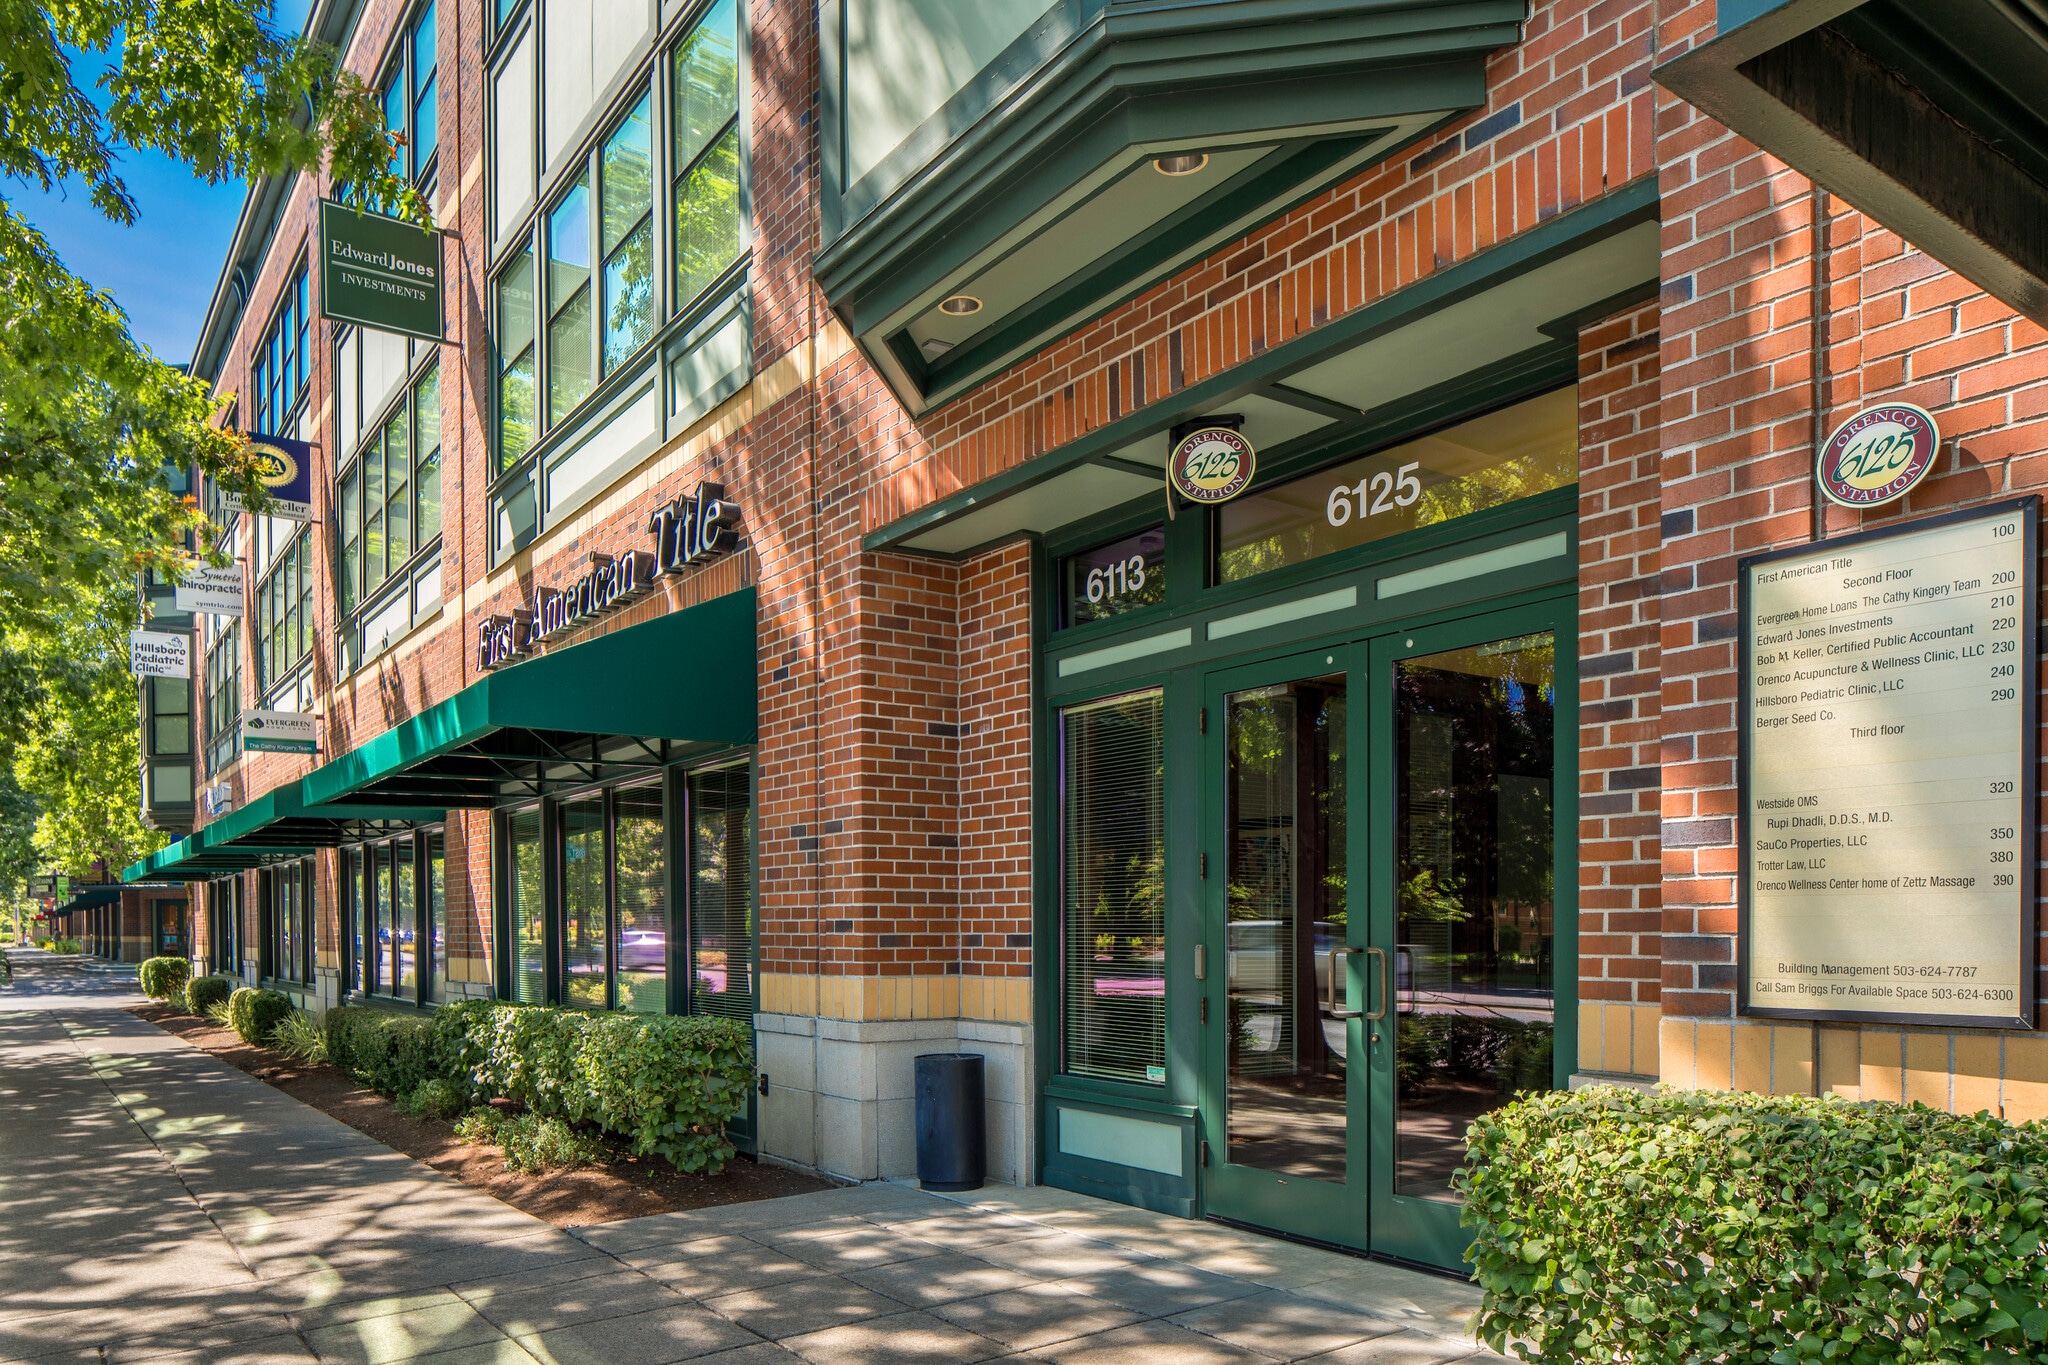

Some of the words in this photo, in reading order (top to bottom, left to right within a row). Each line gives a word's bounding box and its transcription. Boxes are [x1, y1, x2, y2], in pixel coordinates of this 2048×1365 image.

[342, 272, 426, 301] INVESTMENTS
[1835, 410, 1918, 449] ORENCO
[1184, 432, 1242, 454] ORENCO
[1832, 425, 1923, 482] 6125
[1181, 450, 1245, 480] 6125
[1184, 474, 1244, 498] STATION
[1838, 460, 1921, 501] STATION
[1326, 461, 1422, 527] 6125
[1757, 570, 1778, 584] First
[1780, 562, 1828, 580] American
[1830, 558, 1852, 570] Title
[1992, 523, 2016, 538] 100
[180, 580, 242, 594] hiropractic
[195, 567, 241, 583] Symtrio
[476, 607, 525, 672] First
[526, 549, 645, 646] American
[649, 480, 733, 579] Title
[1086, 554, 1146, 603] 6113
[1843, 572, 1882, 589] Second
[1886, 568, 1914, 582] Floor
[196, 601, 242, 610] symtrio.com
[1757, 610, 1799, 626] Evergreen
[1802, 604, 1828, 618] Home
[1830, 600, 1858, 613] Loans
[1862, 596, 1880, 608] The
[1882, 590, 1910, 604] Cathy
[1912, 584, 1950, 598] Kingery
[1953, 578, 1981, 592] Team
[1992, 570, 2016, 585] 200
[1757, 630, 1793, 646] Edward
[1796, 627, 1826, 640] Jones
[1829, 616, 1893, 635] Investments
[1990, 594, 2015, 609] 210
[134, 642, 186, 656] Hillsboro
[1757, 654, 1776, 666] Bob
[1793, 648, 1824, 660] Keller,
[1826, 638, 1870, 655] Certified
[1874, 634, 1906, 648] Public
[1909, 624, 1974, 644] Accountant
[1992, 617, 2016, 630] 220
[134, 652, 184, 666] Pediatric
[135, 663, 164, 673] Clinic
[1757, 674, 1791, 686] Orenco
[1794, 664, 1858, 681] Acupuncture
[1860, 660, 1869, 672] &
[1872, 655, 1920, 670] Wellness
[1924, 649, 1958, 663] Clinic,
[1962, 644, 1985, 658] LLC
[1992, 640, 2016, 654] 230
[1756, 694, 1798, 708] Hillsboro
[1800, 687, 1845, 702] Pediatric
[1884, 678, 1904, 692] LLC
[1990, 664, 2015, 678] 240
[1756, 716, 1789, 728] Berger
[1792, 712, 1816, 724] Seed
[1820, 710, 1836, 720] Co.
[1991, 688, 2015, 702] 290
[266, 719, 310, 728] EVERGREEN
[1850, 726, 1876, 738] Third
[1880, 724, 1905, 736] floor
[1756, 798, 1795, 810] Westside
[1798, 796, 1818, 807] OMS
[1990, 781, 2014, 794] 320
[1767, 818, 1789, 830] Rupi
[1792, 816, 1826, 828] Dhadli,
[1830, 813, 1865, 825] D.D.S.,
[1868, 812, 1893, 823] M.D.
[1756, 840, 1788, 850] SauCo
[1790, 836, 1844, 850] Properties,
[1848, 835, 1868, 846] LLC
[1990, 828, 2014, 840] 350
[1757, 860, 1784, 871] Trotter
[1786, 860, 1806, 871] Law,
[1808, 858, 1826, 869] LLC
[1990, 851, 2014, 862] 380
[1756, 880, 1786, 890] Orenco
[1788, 880, 1827, 890] Wellness
[1830, 878, 1860, 889] Center
[1862, 878, 1888, 888] home
[1890, 877, 1900, 888] of
[1902, 876, 1927, 888] Zettz
[1930, 876, 1976, 889] Massage
[1993, 874, 2014, 886] 390
[1778, 962, 1818, 976] Building
[1821, 964, 1890, 976] Management
[1893, 966, 1978, 978] 503-624-7787
[1756, 982, 1772, 992] Call
[1774, 982, 1796, 993] Sam
[1798, 984, 1828, 996] Briggs
[1830, 984, 1846, 995] For
[1848, 985, 1893, 997] Available
[1896, 986, 1928, 1000] Space
[1932, 988, 2014, 1001] 503-624-6300
